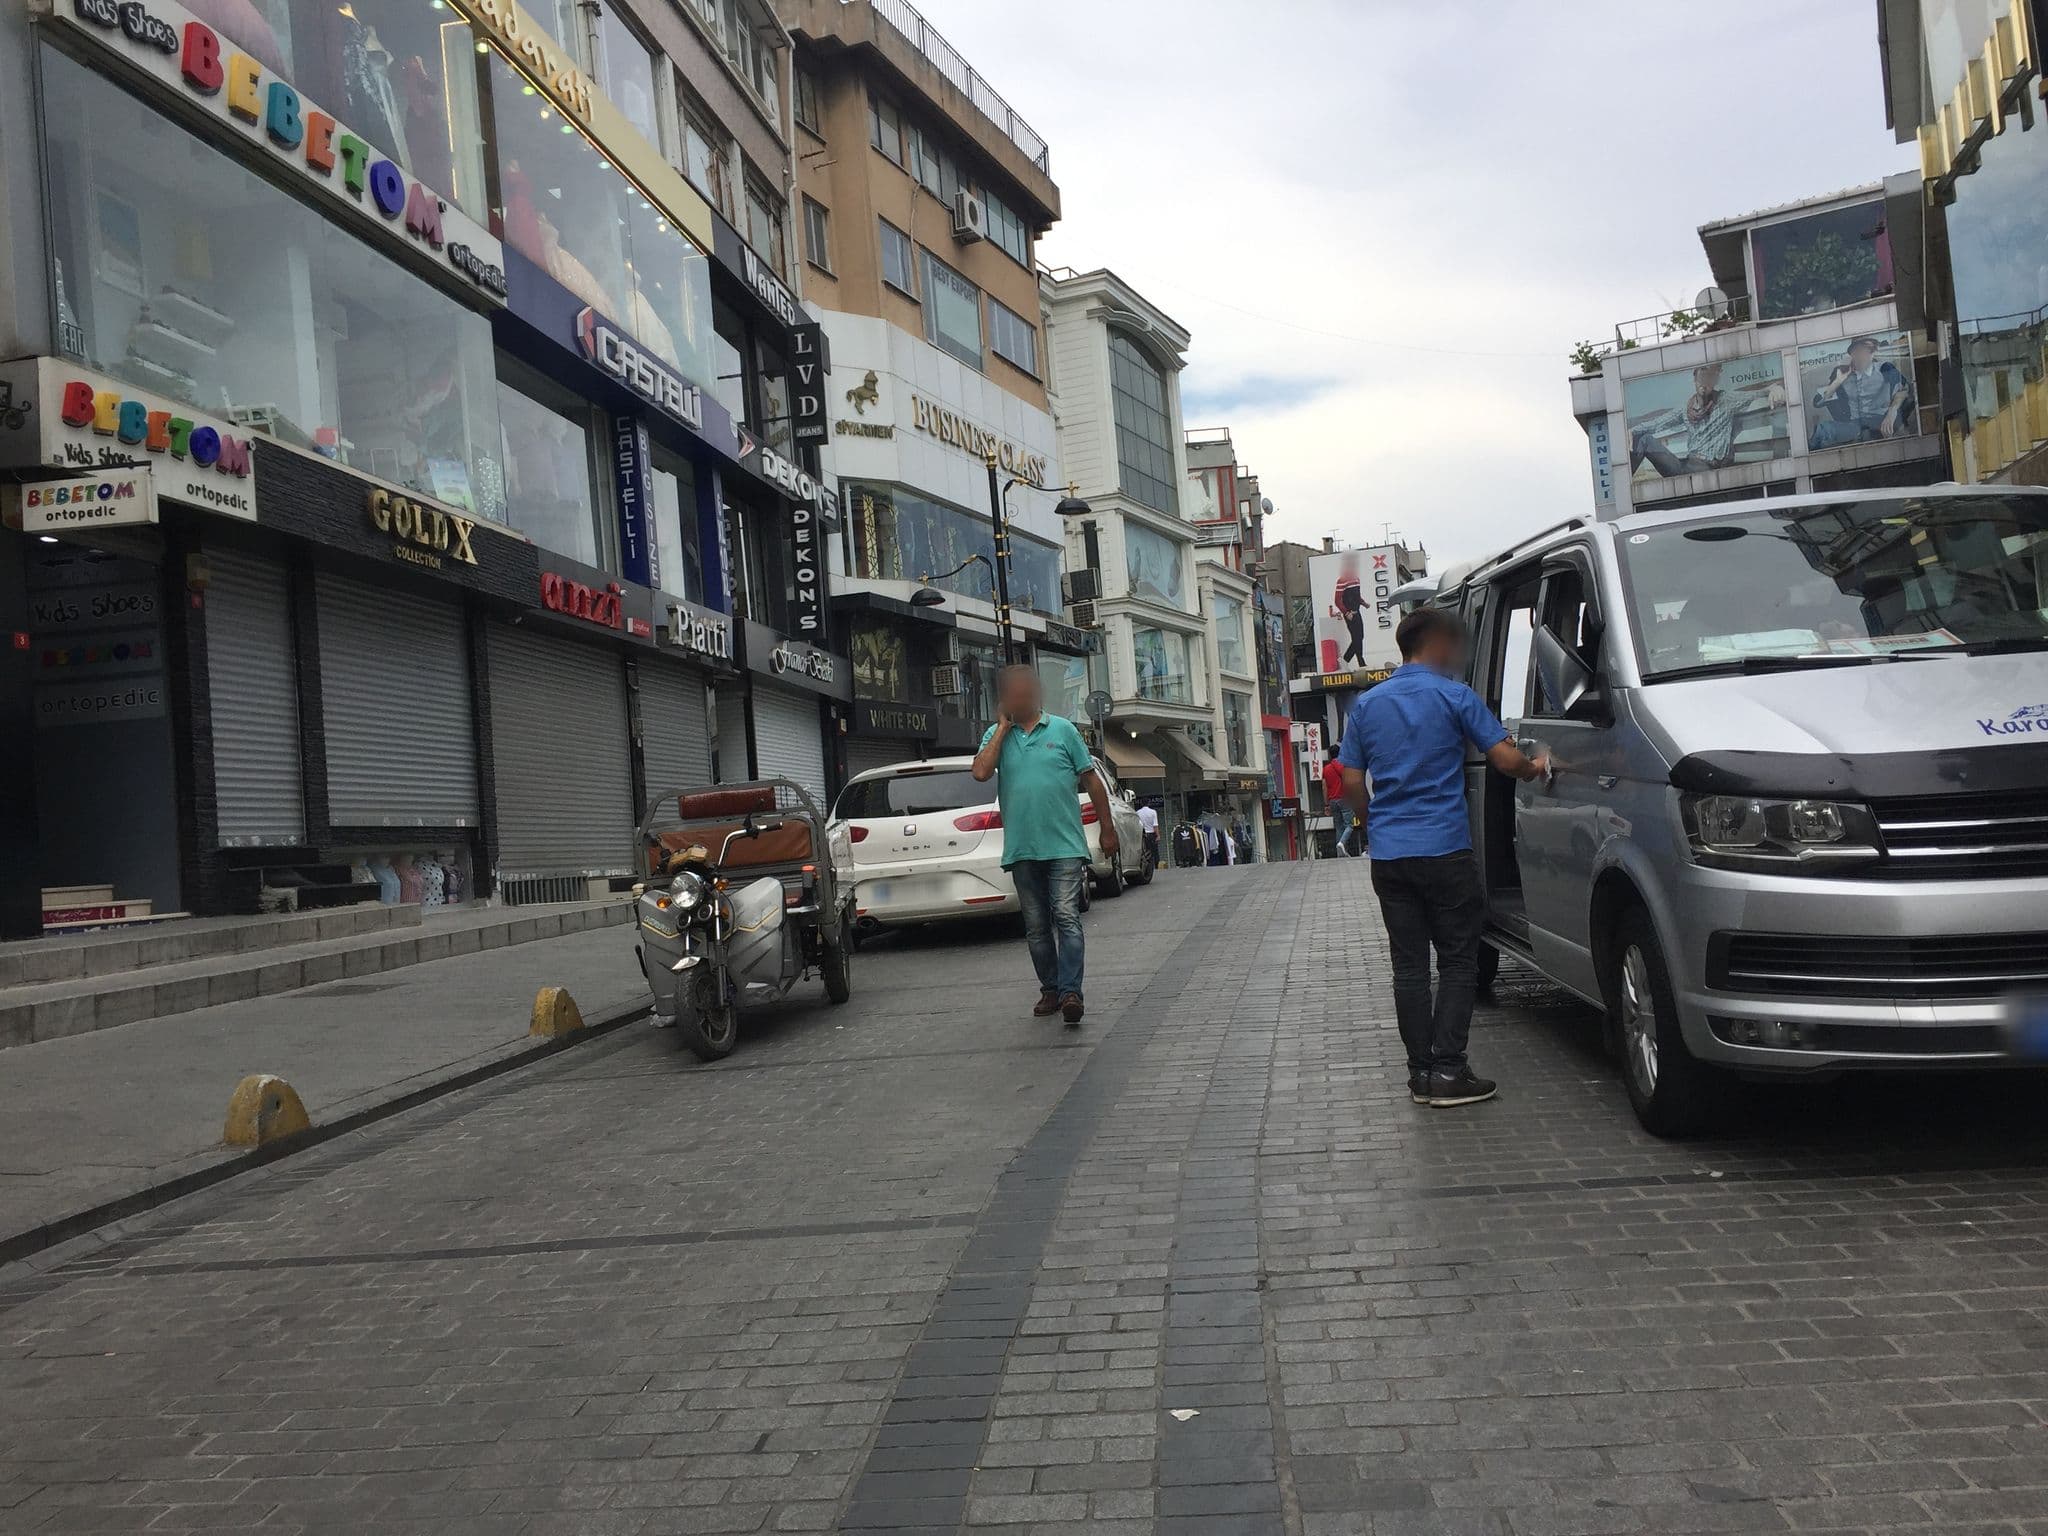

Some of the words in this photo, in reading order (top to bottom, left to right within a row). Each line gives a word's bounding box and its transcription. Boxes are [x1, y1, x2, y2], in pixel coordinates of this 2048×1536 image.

[127, 6, 177, 50] Shoes
[181, 21, 445, 246] BEBETOM
[450, 243, 508, 295] ortopedic
[794, 332, 818, 417] LVD
[1730, 368, 1775, 384] TONELLI
[1800, 352, 1845, 367] TONELLI
[61, 381, 251, 478] BEBETOM
[911, 393, 996, 460] BUSINESS
[999, 439, 1047, 487] CLASS
[64, 443, 94, 465] Kids
[1595, 422, 1609, 499] TONELLI
[27, 480, 136, 508] BEBETOM
[46, 505, 117, 523] ortopedic
[186, 482, 248, 511] ortopedic
[639, 432, 652, 491] BIG
[646, 504, 660, 582] SIZE
[793, 509, 817, 630] DEKON'S
[34, 600, 80, 623] Kids
[91, 592, 155, 618] Shoes
[540, 571, 623, 630] anzi
[674, 602, 728, 659] Piatti
[42, 688, 160, 713] ortopedic
[870, 709, 904, 730] WHITE
[906, 712, 928, 732] FOX
[892, 844, 931, 852] LEON
